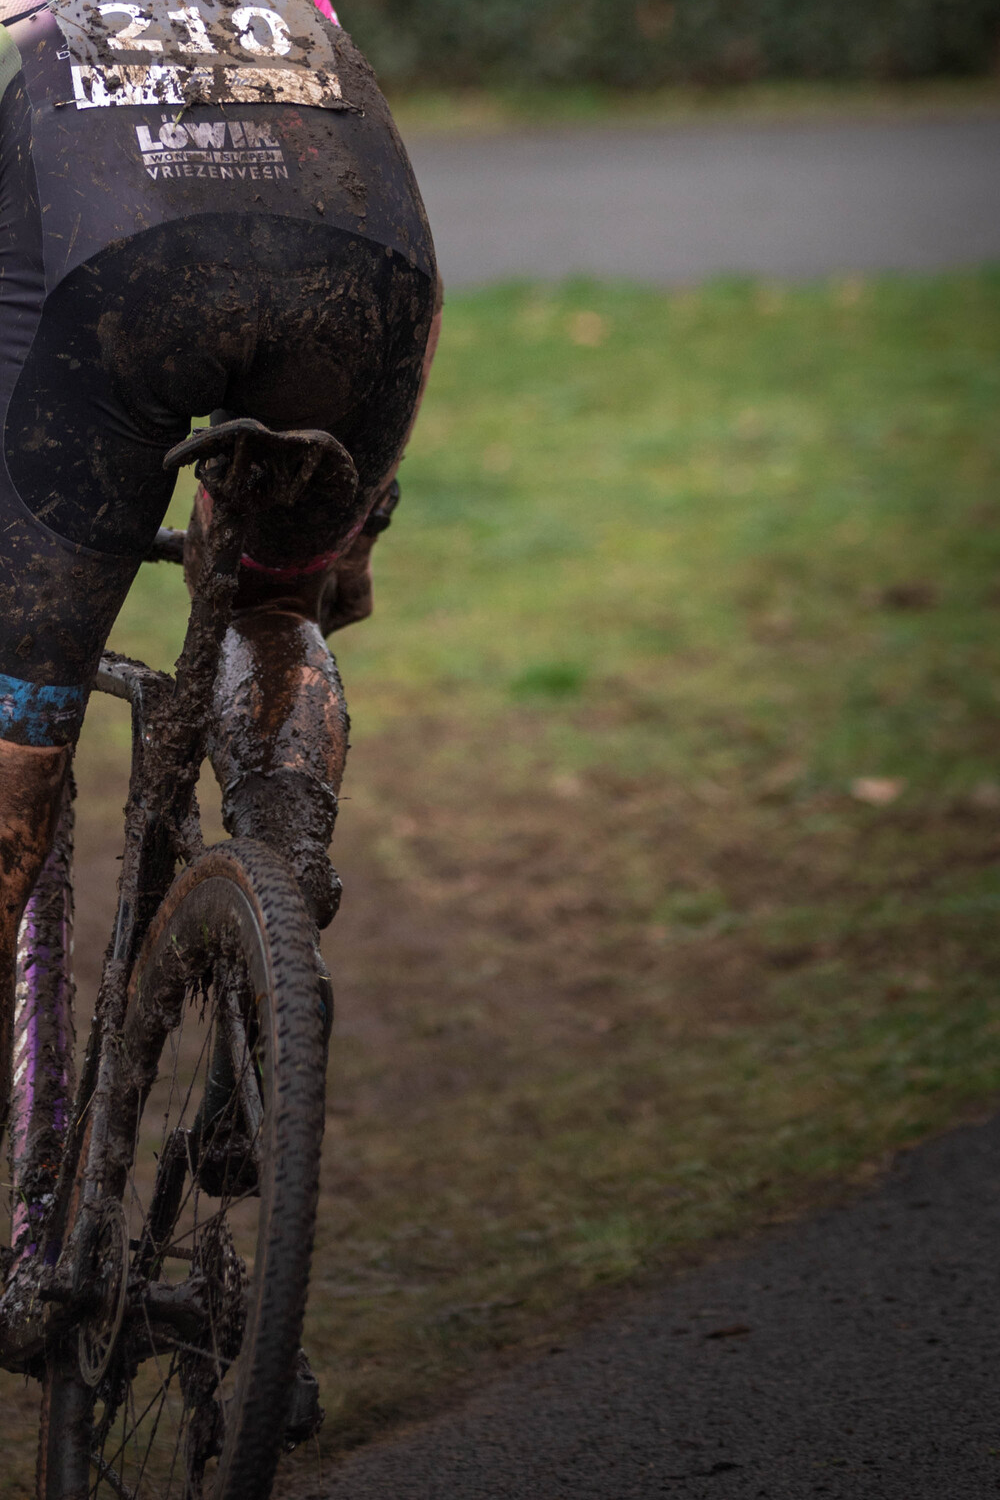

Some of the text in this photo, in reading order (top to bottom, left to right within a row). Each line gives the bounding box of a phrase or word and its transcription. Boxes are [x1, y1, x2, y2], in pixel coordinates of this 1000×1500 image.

[96, 2, 292, 56] 210
[135, 113, 280, 152] LÖWIK
[146, 163, 290, 181] VRIEZENVEEN
